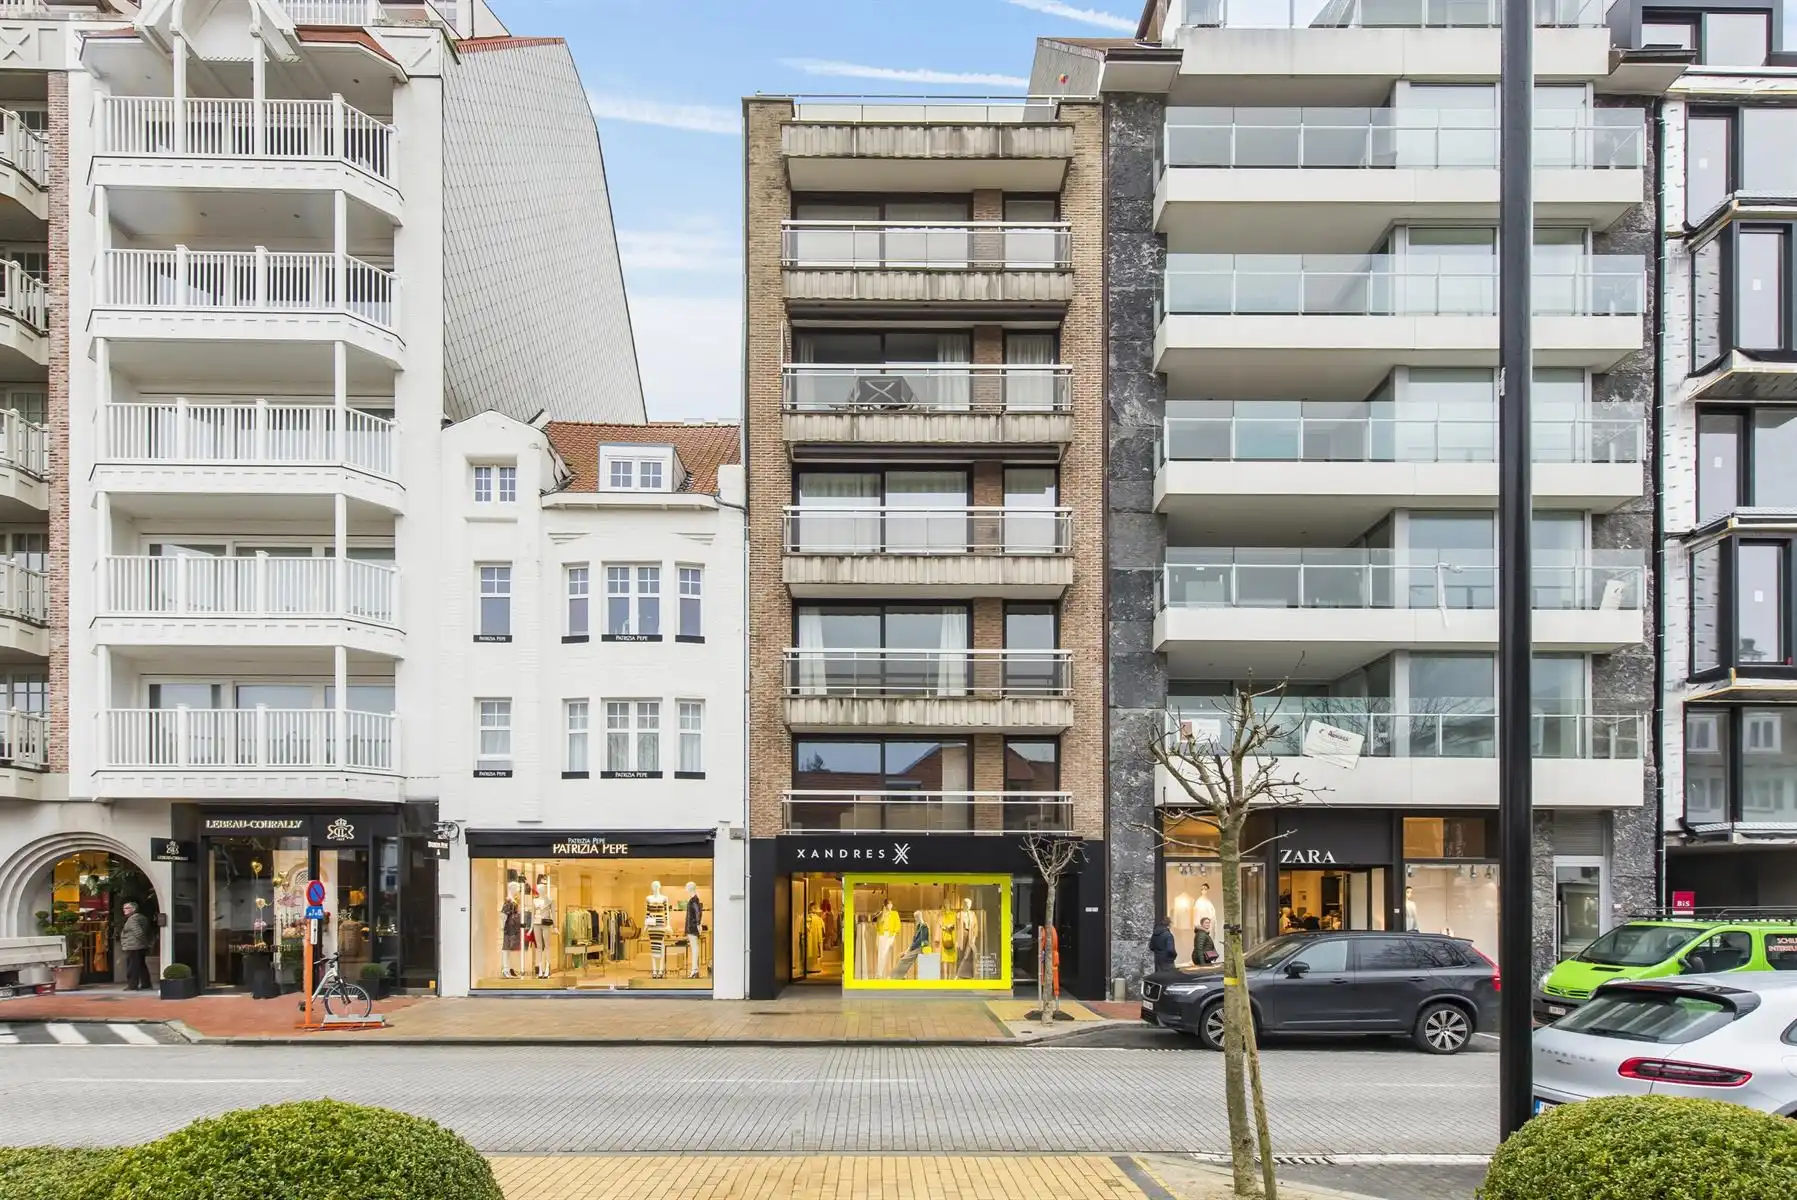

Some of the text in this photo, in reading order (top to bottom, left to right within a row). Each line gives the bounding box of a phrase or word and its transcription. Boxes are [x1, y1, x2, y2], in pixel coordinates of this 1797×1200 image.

[205, 819, 303, 829] LEBEAU-COURALLY
[552, 843, 628, 855] PATRIZIA PEPE
[797, 848, 886, 859] XANDRES
[1280, 849, 1337, 864] ZARA
